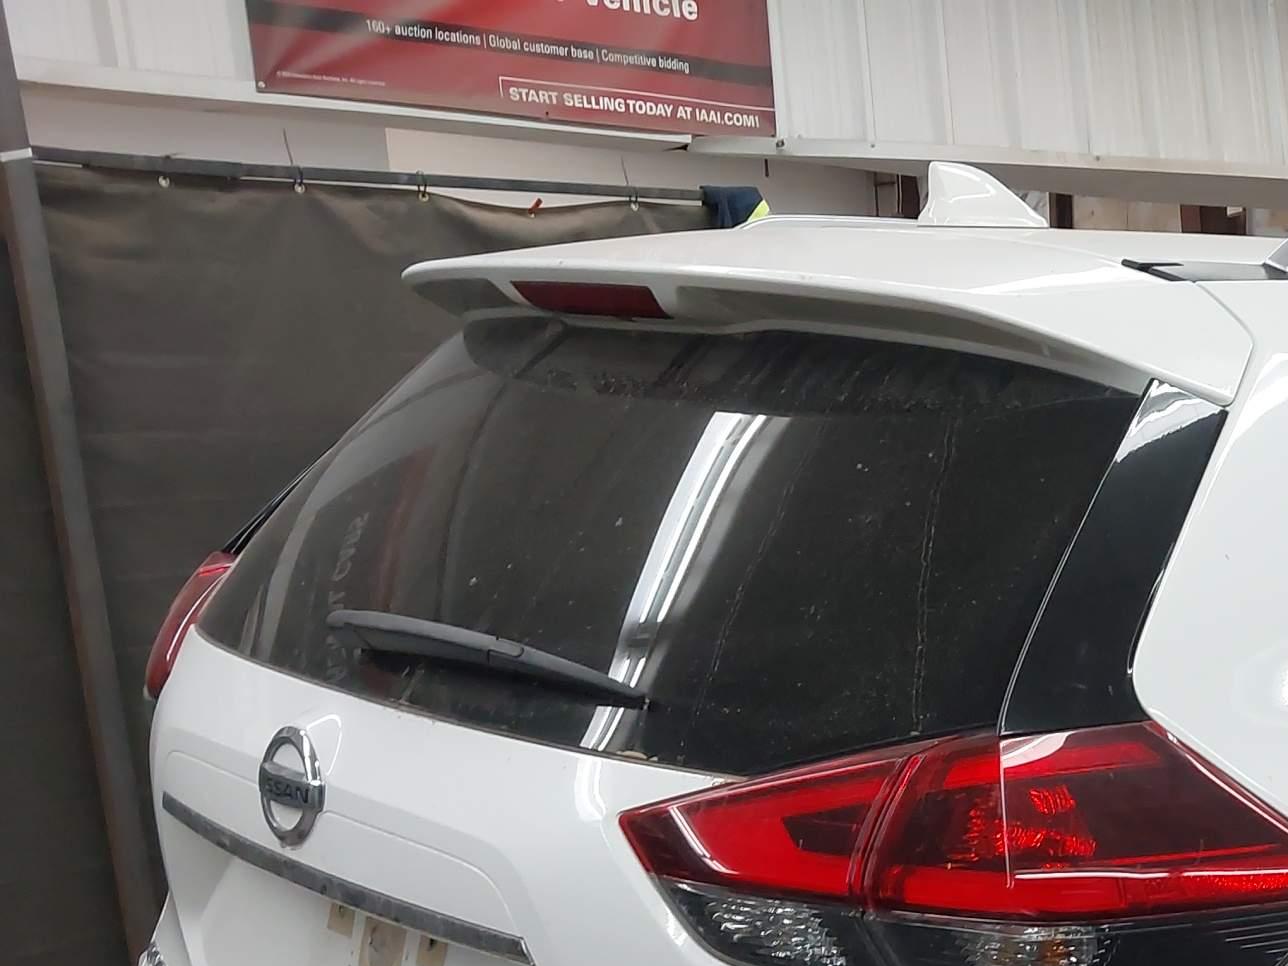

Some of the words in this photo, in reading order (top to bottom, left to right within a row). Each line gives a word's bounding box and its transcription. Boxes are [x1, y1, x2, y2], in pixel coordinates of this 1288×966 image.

[586, 0, 698, 20] icle
[394, 23, 433, 40] auction
[435, 26, 481, 45] locations
[488, 34, 521, 51] Global
[523, 41, 569, 57] customer
[571, 45, 594, 60] base
[601, 49, 657, 67] Competitive
[658, 56, 690, 74] bidding
[509, 87, 558, 105] START
[563, 92, 625, 112] SELLING
[626, 98, 673, 118] TODAY
[676, 106, 693, 120] AT
[695, 109, 760, 128] IAAI.COM!
